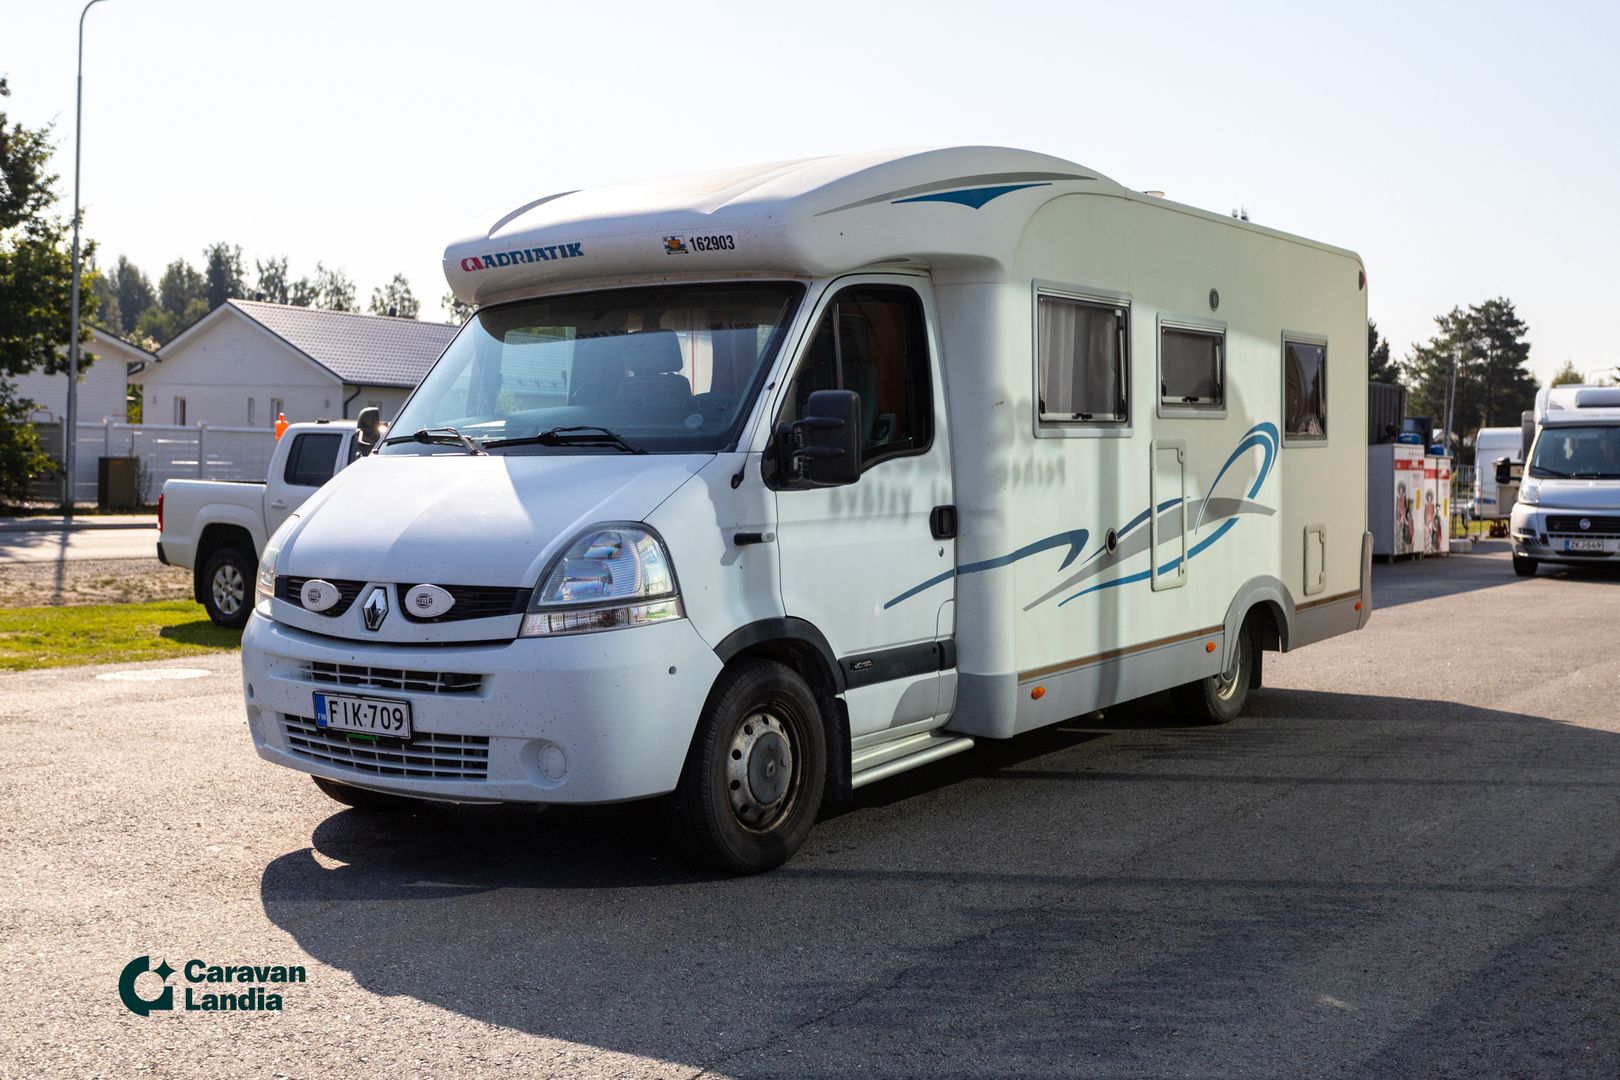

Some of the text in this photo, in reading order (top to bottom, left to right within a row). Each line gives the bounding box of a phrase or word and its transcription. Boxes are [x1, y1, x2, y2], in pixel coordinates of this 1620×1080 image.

[689, 235, 735, 251] 162903
[416, 597, 433, 606] HELLA
[329, 700, 404, 731] FIK-709
